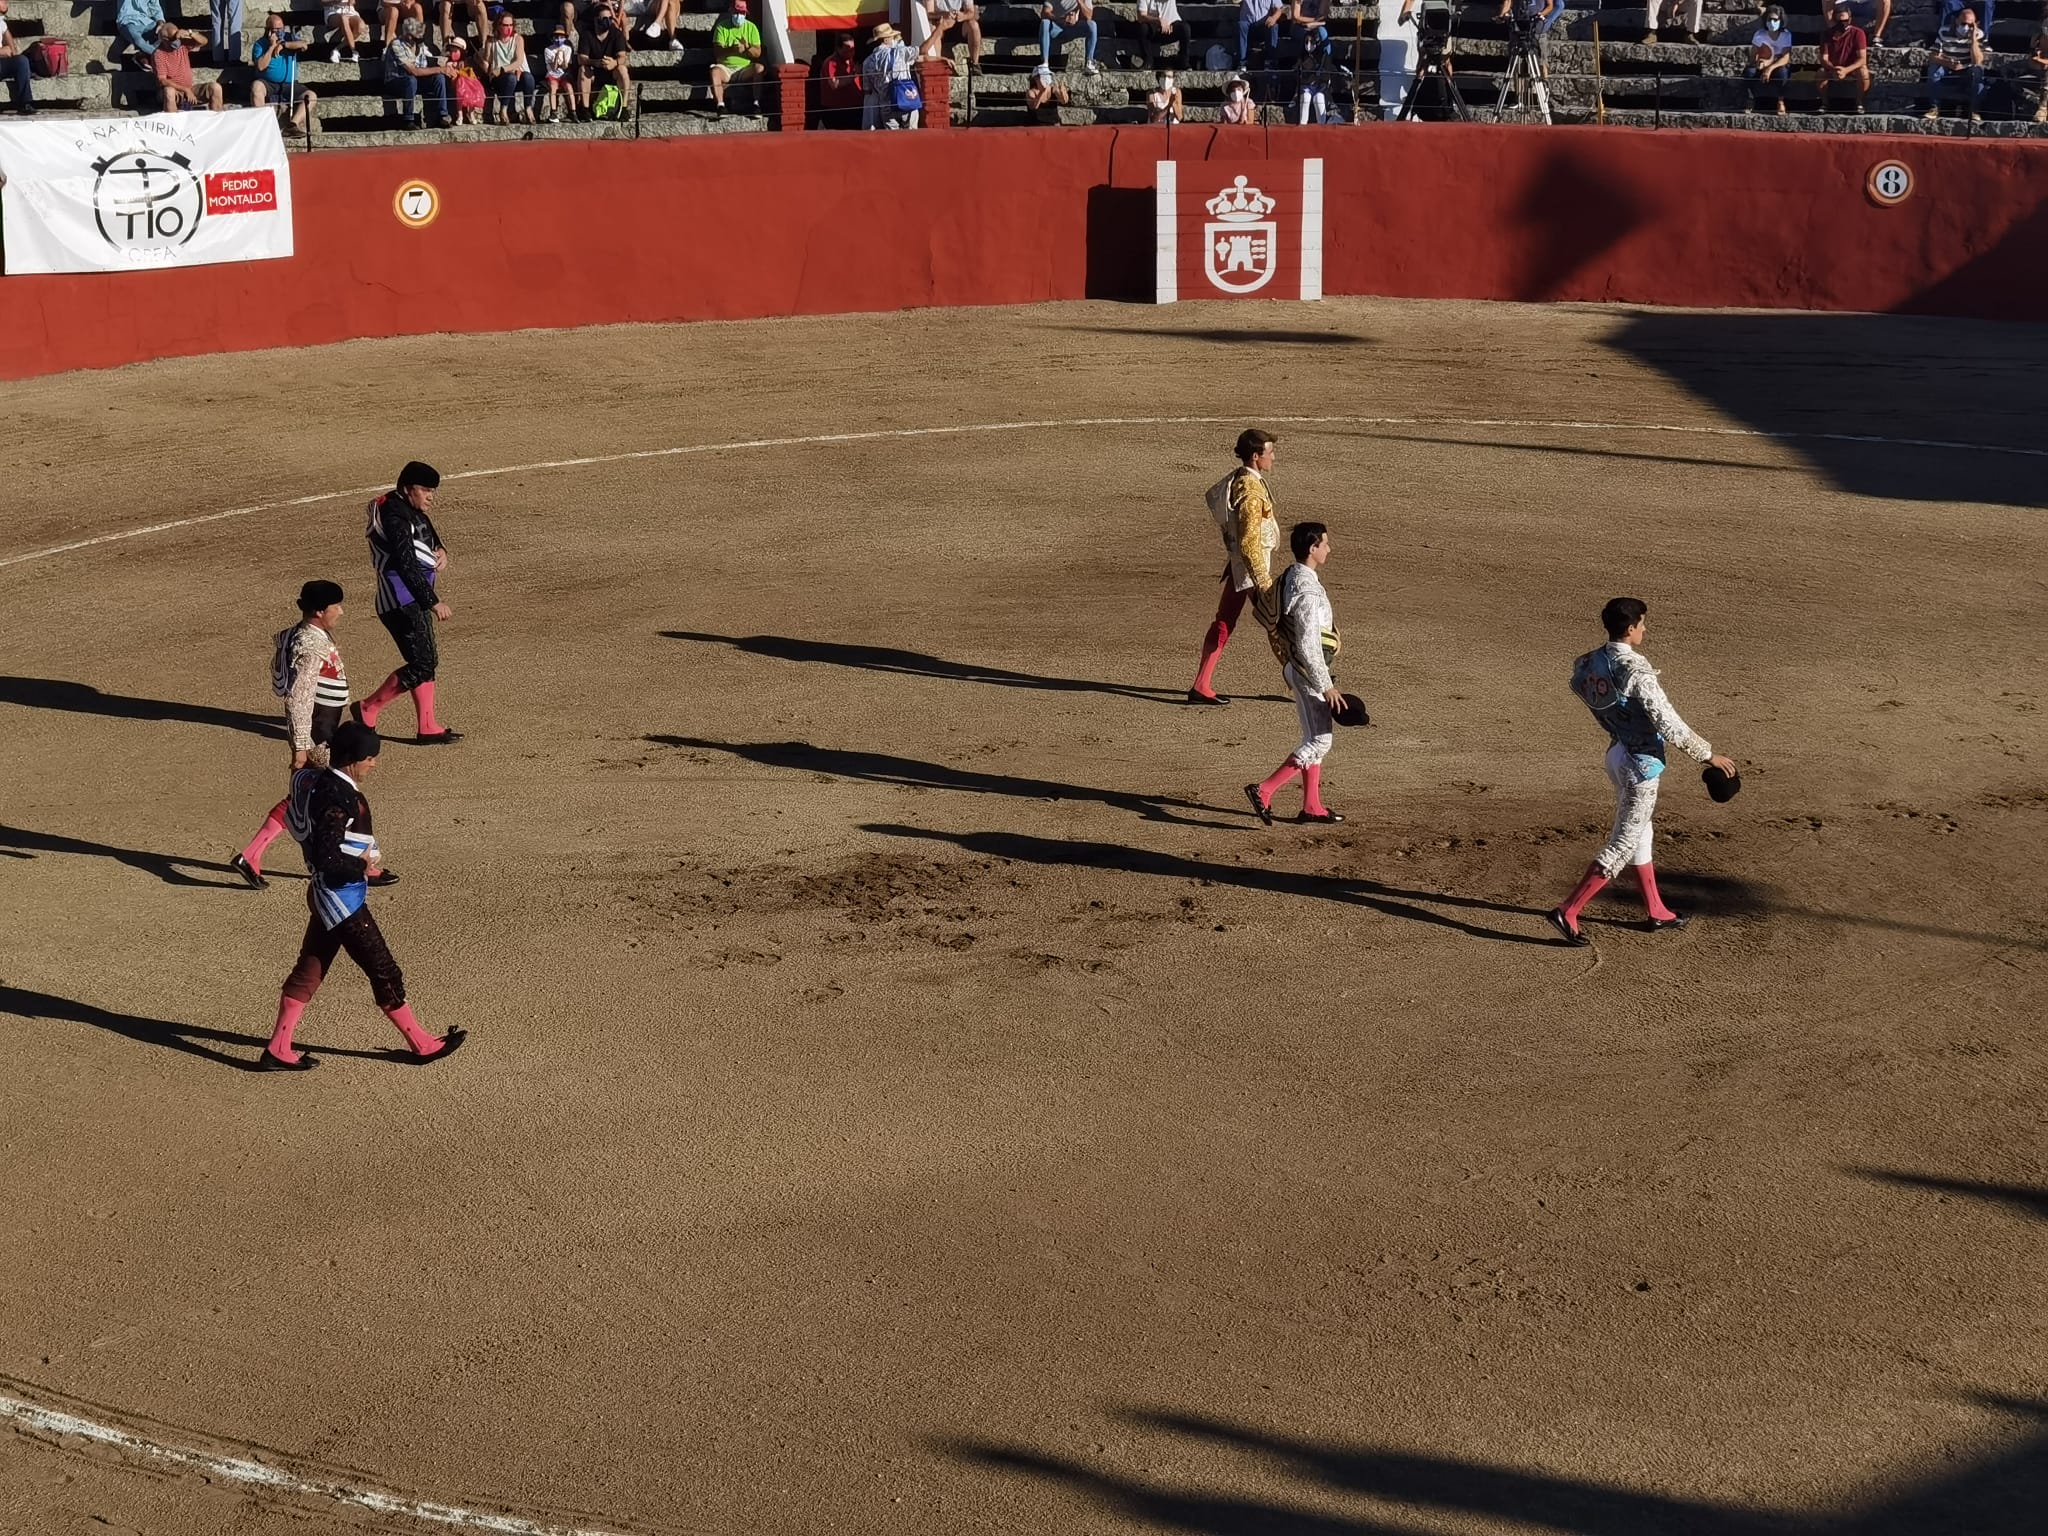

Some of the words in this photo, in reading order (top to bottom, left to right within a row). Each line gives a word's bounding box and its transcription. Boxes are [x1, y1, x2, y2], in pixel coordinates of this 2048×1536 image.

[75, 124, 120, 151] PÑA
[222, 178, 258, 191] PEDRO
[1882, 169, 1901, 194] 8
[209, 192, 273, 207] MONTALDO
[408, 190, 424, 215] 7
